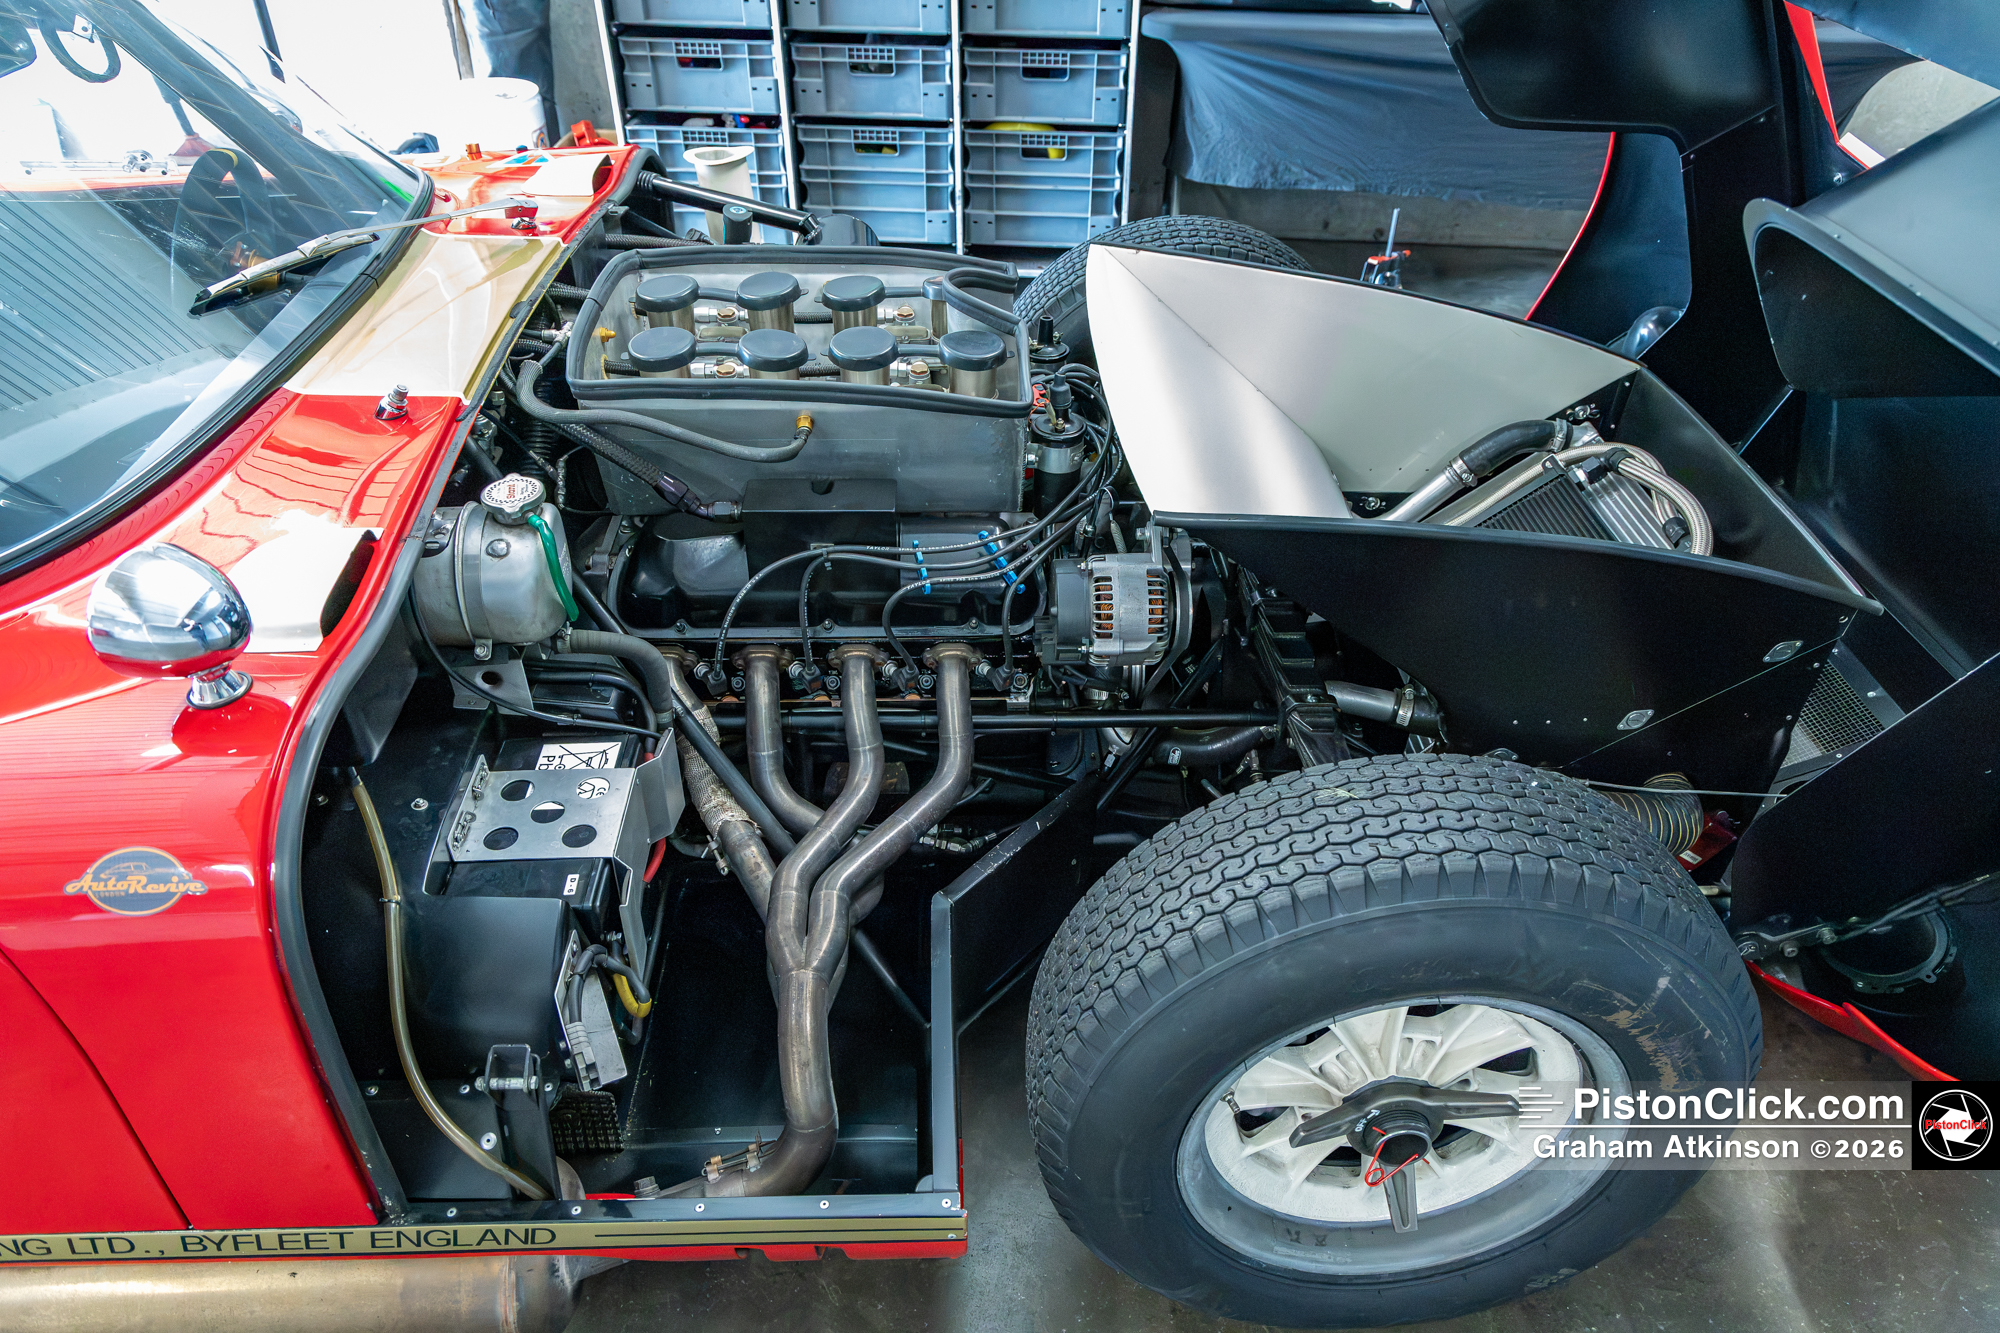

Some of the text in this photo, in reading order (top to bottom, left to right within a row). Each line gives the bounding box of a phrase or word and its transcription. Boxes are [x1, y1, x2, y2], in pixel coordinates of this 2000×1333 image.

[906, 579, 931, 590] TAYLOR
[538, 755, 556, 770] Pb
[65, 873, 205, 894] AutoRevive
[180, 1233, 354, 1253] BYFLEET
[370, 1228, 557, 1248] ENGLAND
